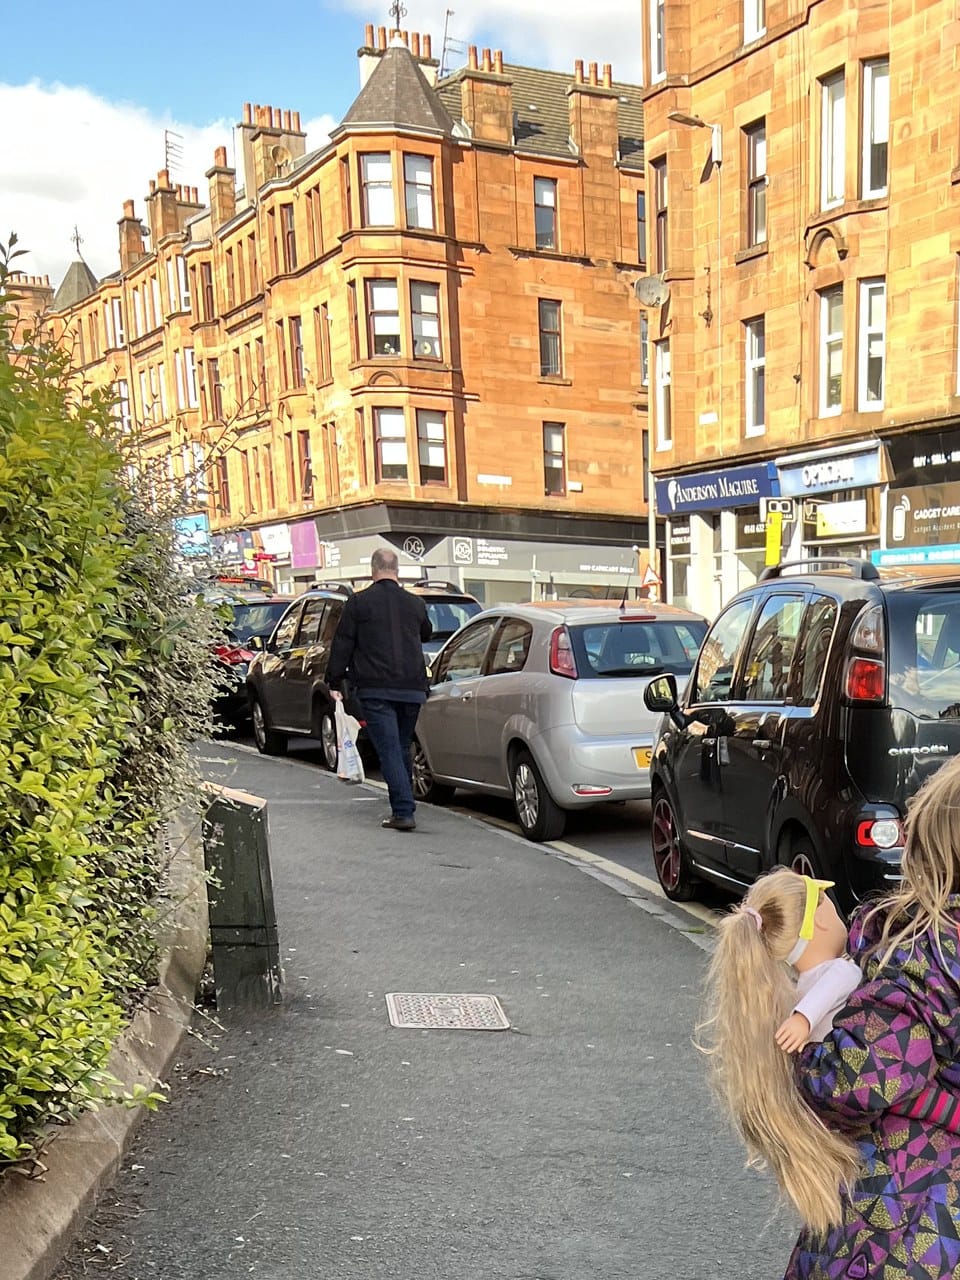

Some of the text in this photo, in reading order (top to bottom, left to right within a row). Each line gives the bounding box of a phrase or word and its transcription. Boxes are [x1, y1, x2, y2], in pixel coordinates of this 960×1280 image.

[913, 456, 927, 468] BUY
[931, 454, 947, 466] SELL
[675, 477, 759, 504] ANDERSON MAGUIRE
[913, 508, 941, 520] GADGET
[942, 505, 960, 518] CARE
[913, 523, 931, 534] Gadget
[932, 522, 955, 531] Accident
